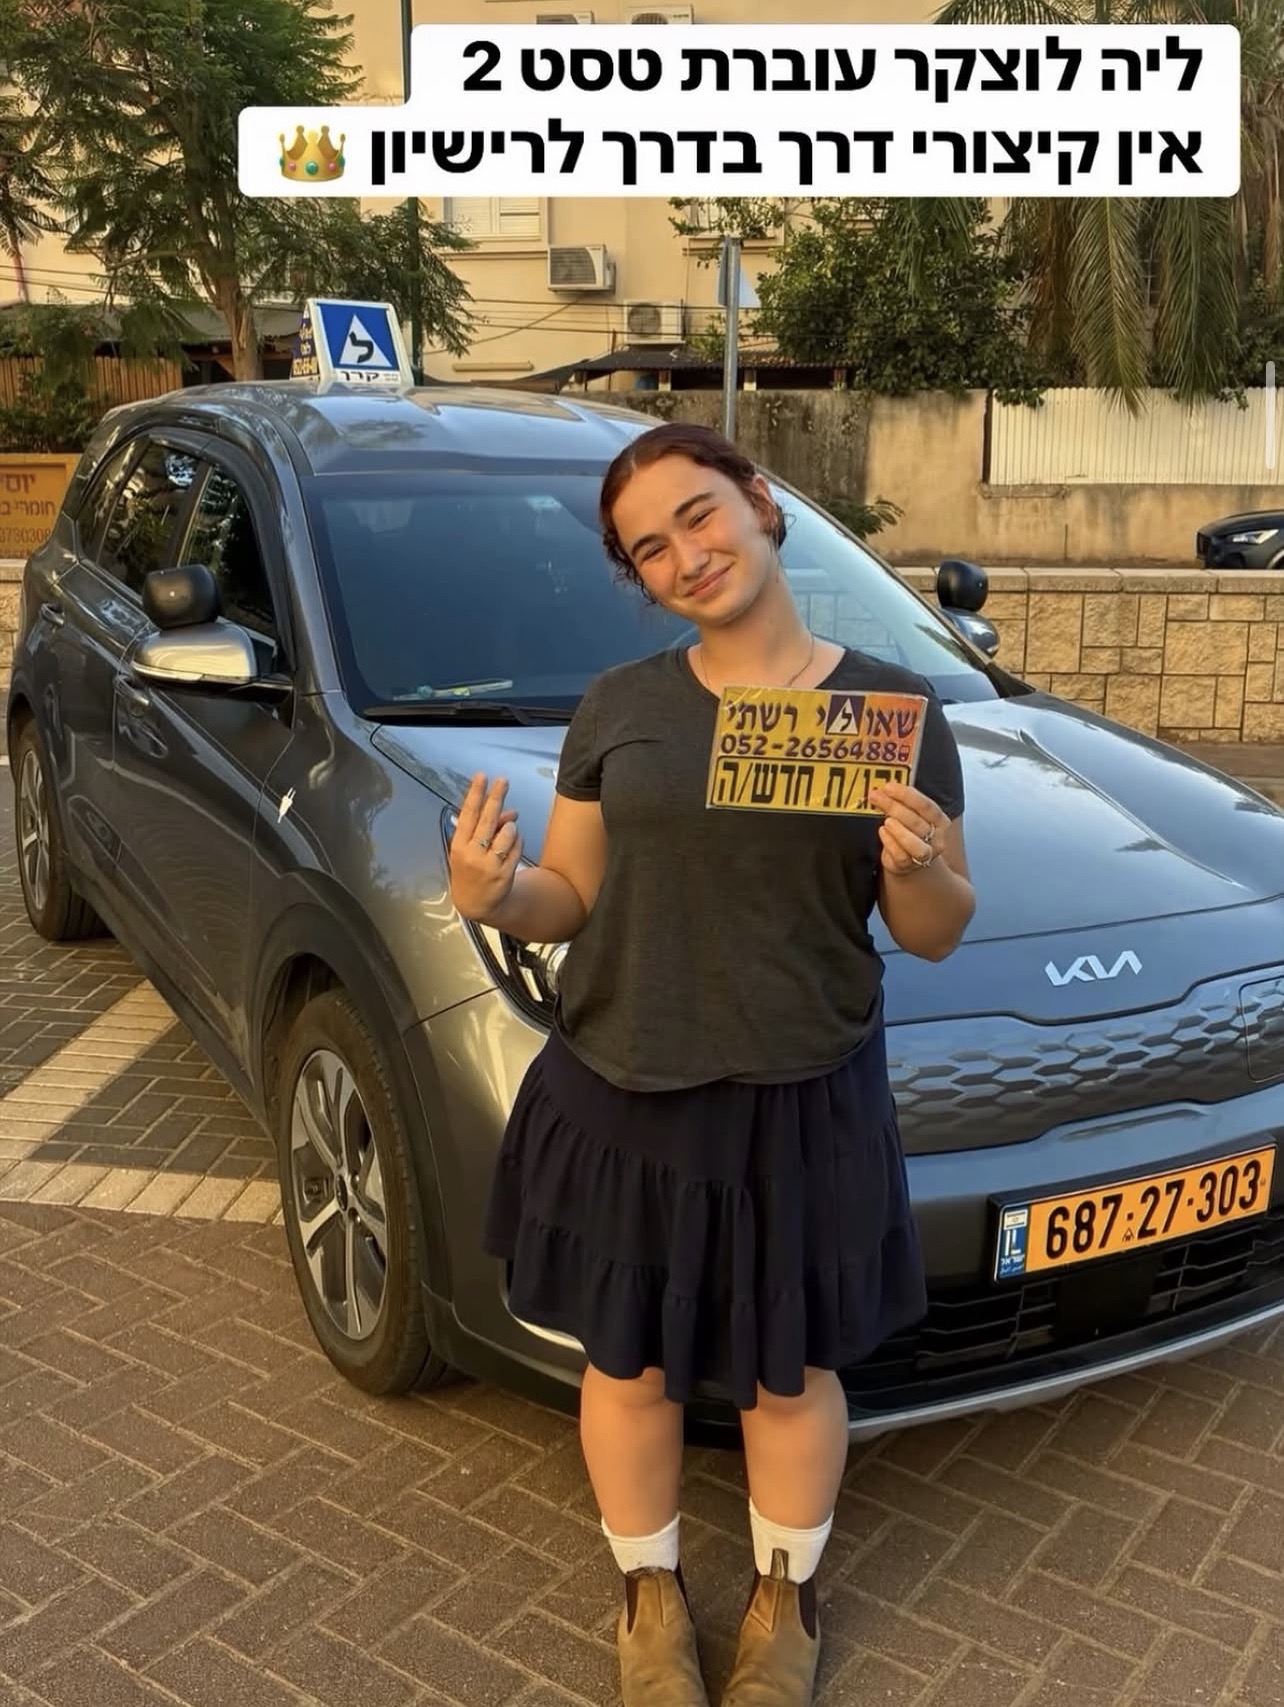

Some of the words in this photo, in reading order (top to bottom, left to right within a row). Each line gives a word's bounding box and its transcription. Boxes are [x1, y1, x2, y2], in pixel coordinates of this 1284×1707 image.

[349, 331, 374, 364] ל
[726, 700, 799, 734] רשתי
[720, 734, 898, 763] 052-2656488
[717, 761, 815, 807] חדש/ה
[1045, 950, 1143, 987] KIA
